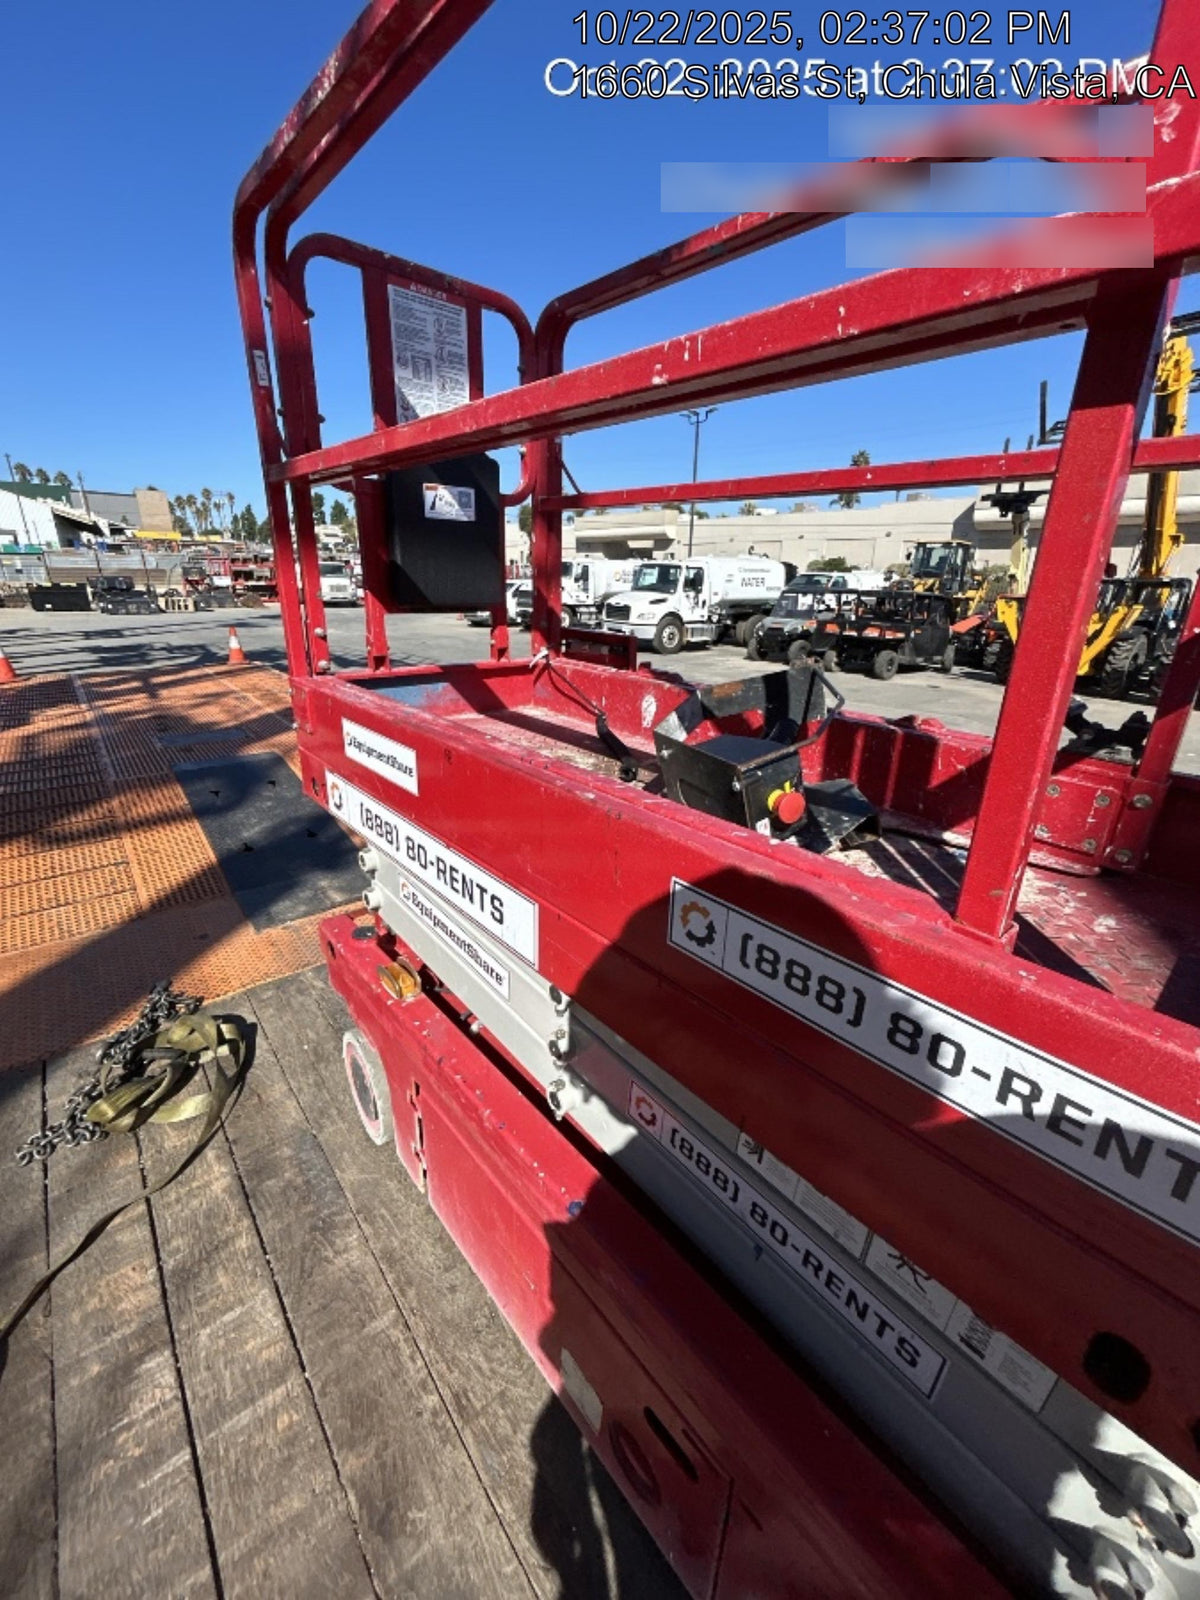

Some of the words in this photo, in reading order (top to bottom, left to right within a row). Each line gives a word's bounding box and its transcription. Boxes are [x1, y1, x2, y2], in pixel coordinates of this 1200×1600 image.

[741, 577, 766, 588] WATER
[360, 801, 400, 852] (888)
[406, 836, 505, 926] 80-RENTS
[411, 891, 503, 987] EquipmentShare
[739, 932, 867, 1028] (888)
[670, 1127, 740, 1204] (888)
[749, 1200, 922, 1369] 80-RENTS
